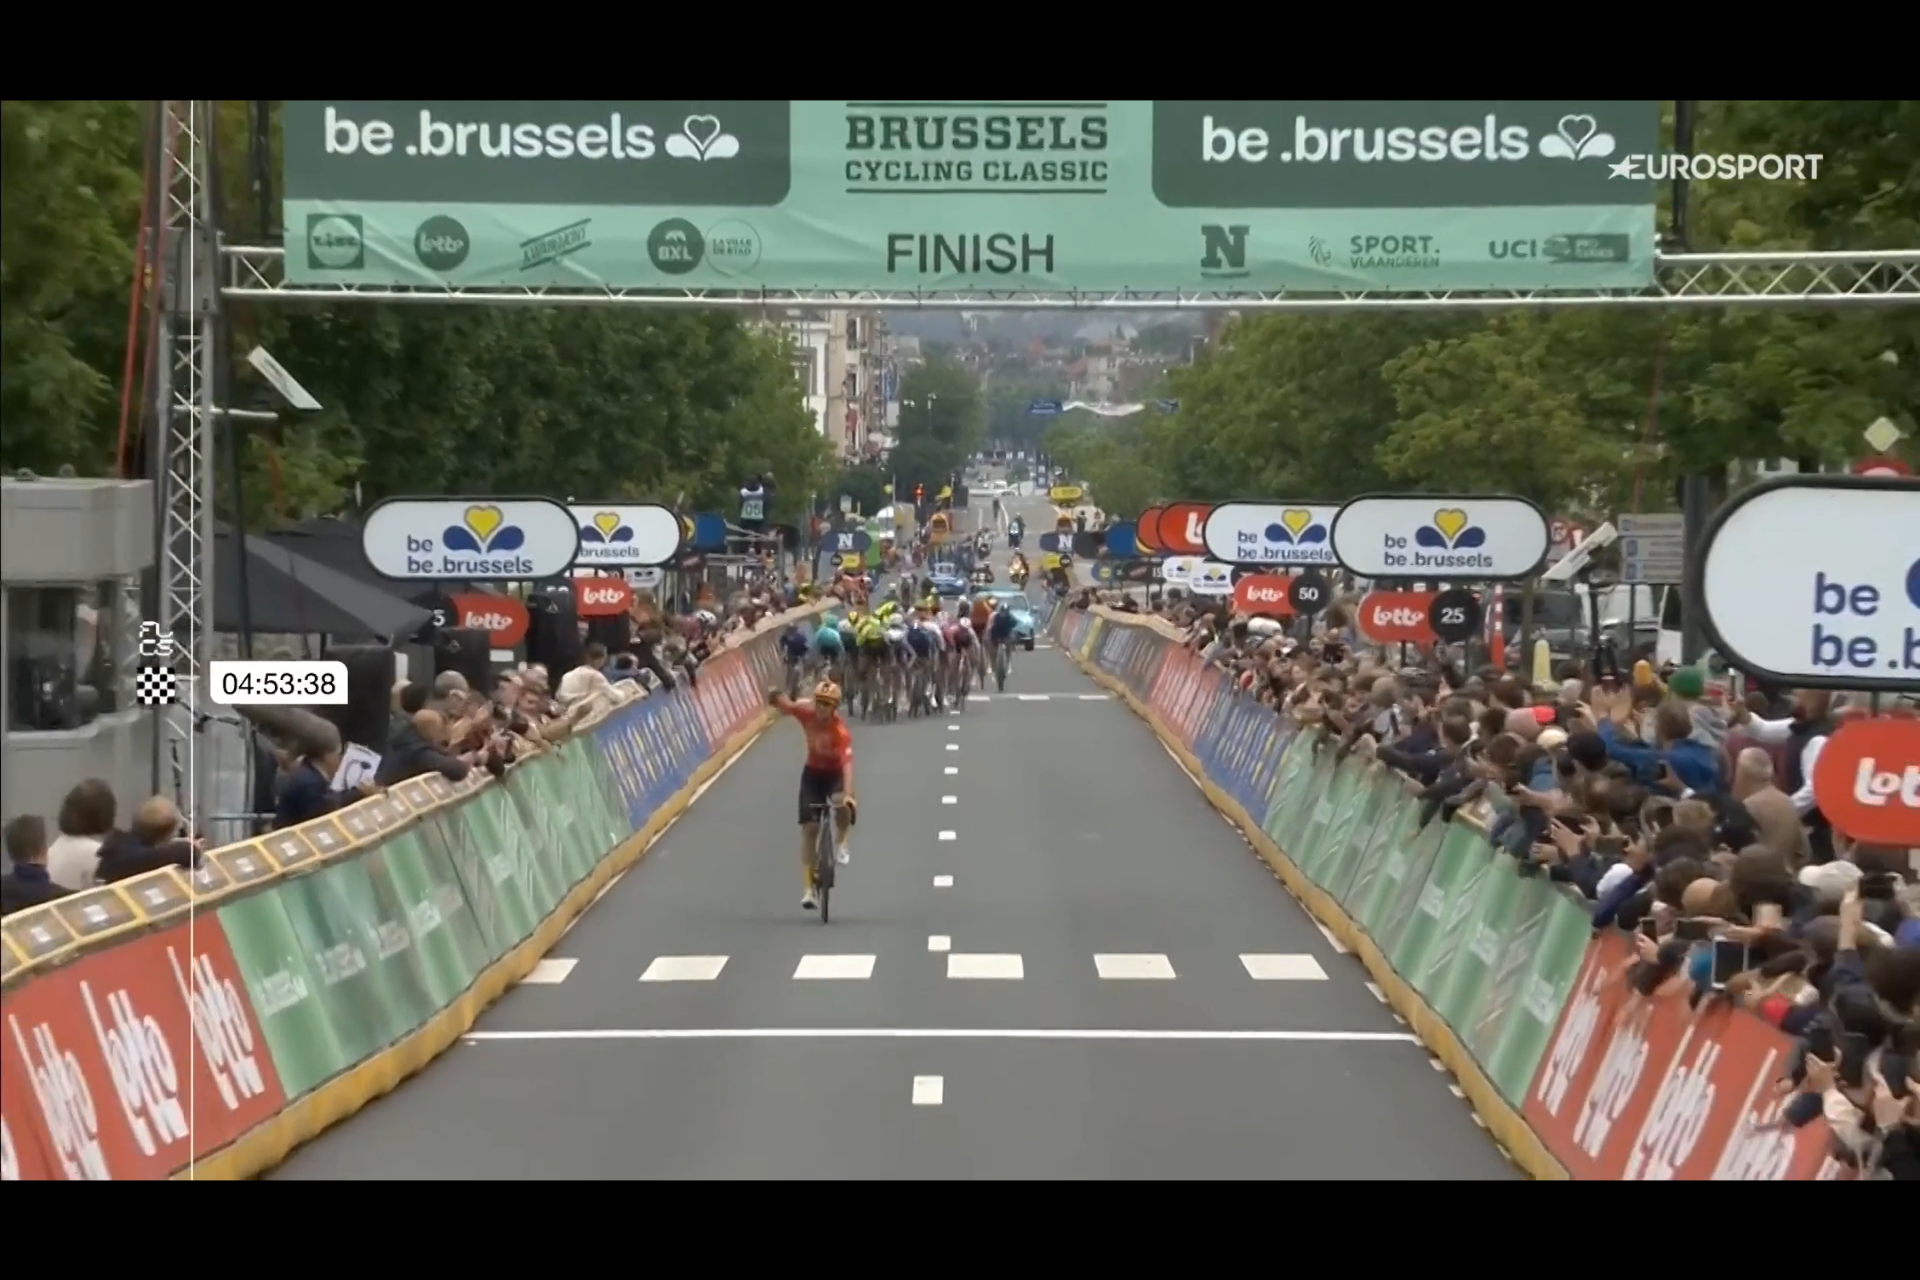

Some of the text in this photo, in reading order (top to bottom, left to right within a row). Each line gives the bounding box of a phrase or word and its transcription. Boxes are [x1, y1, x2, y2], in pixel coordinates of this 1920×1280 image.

[325, 106, 656, 159] be .brussels
[845, 115, 1108, 150] BRUSSELS
[1202, 113, 1530, 162] be .brussels
[845, 160, 1108, 182] CYCLING CLASSIC
[658, 245, 694, 262] BXL
[886, 233, 1054, 274] FINISH
[1200, 224, 1250, 269] N
[1488, 239, 1537, 260] UCI
[407, 534, 434, 552] be
[838, 532, 854, 547] N
[1237, 529, 1258, 544] be
[1384, 534, 1408, 549] be
[1237, 546, 1258, 560] be
[1384, 552, 1408, 567] be
[407, 555, 434, 574] be
[1298, 586, 1319, 601] 50
[1814, 571, 1880, 616] be
[433, 609, 446, 627] 5
[1441, 606, 1466, 624] 25
[1811, 623, 1878, 668] be
